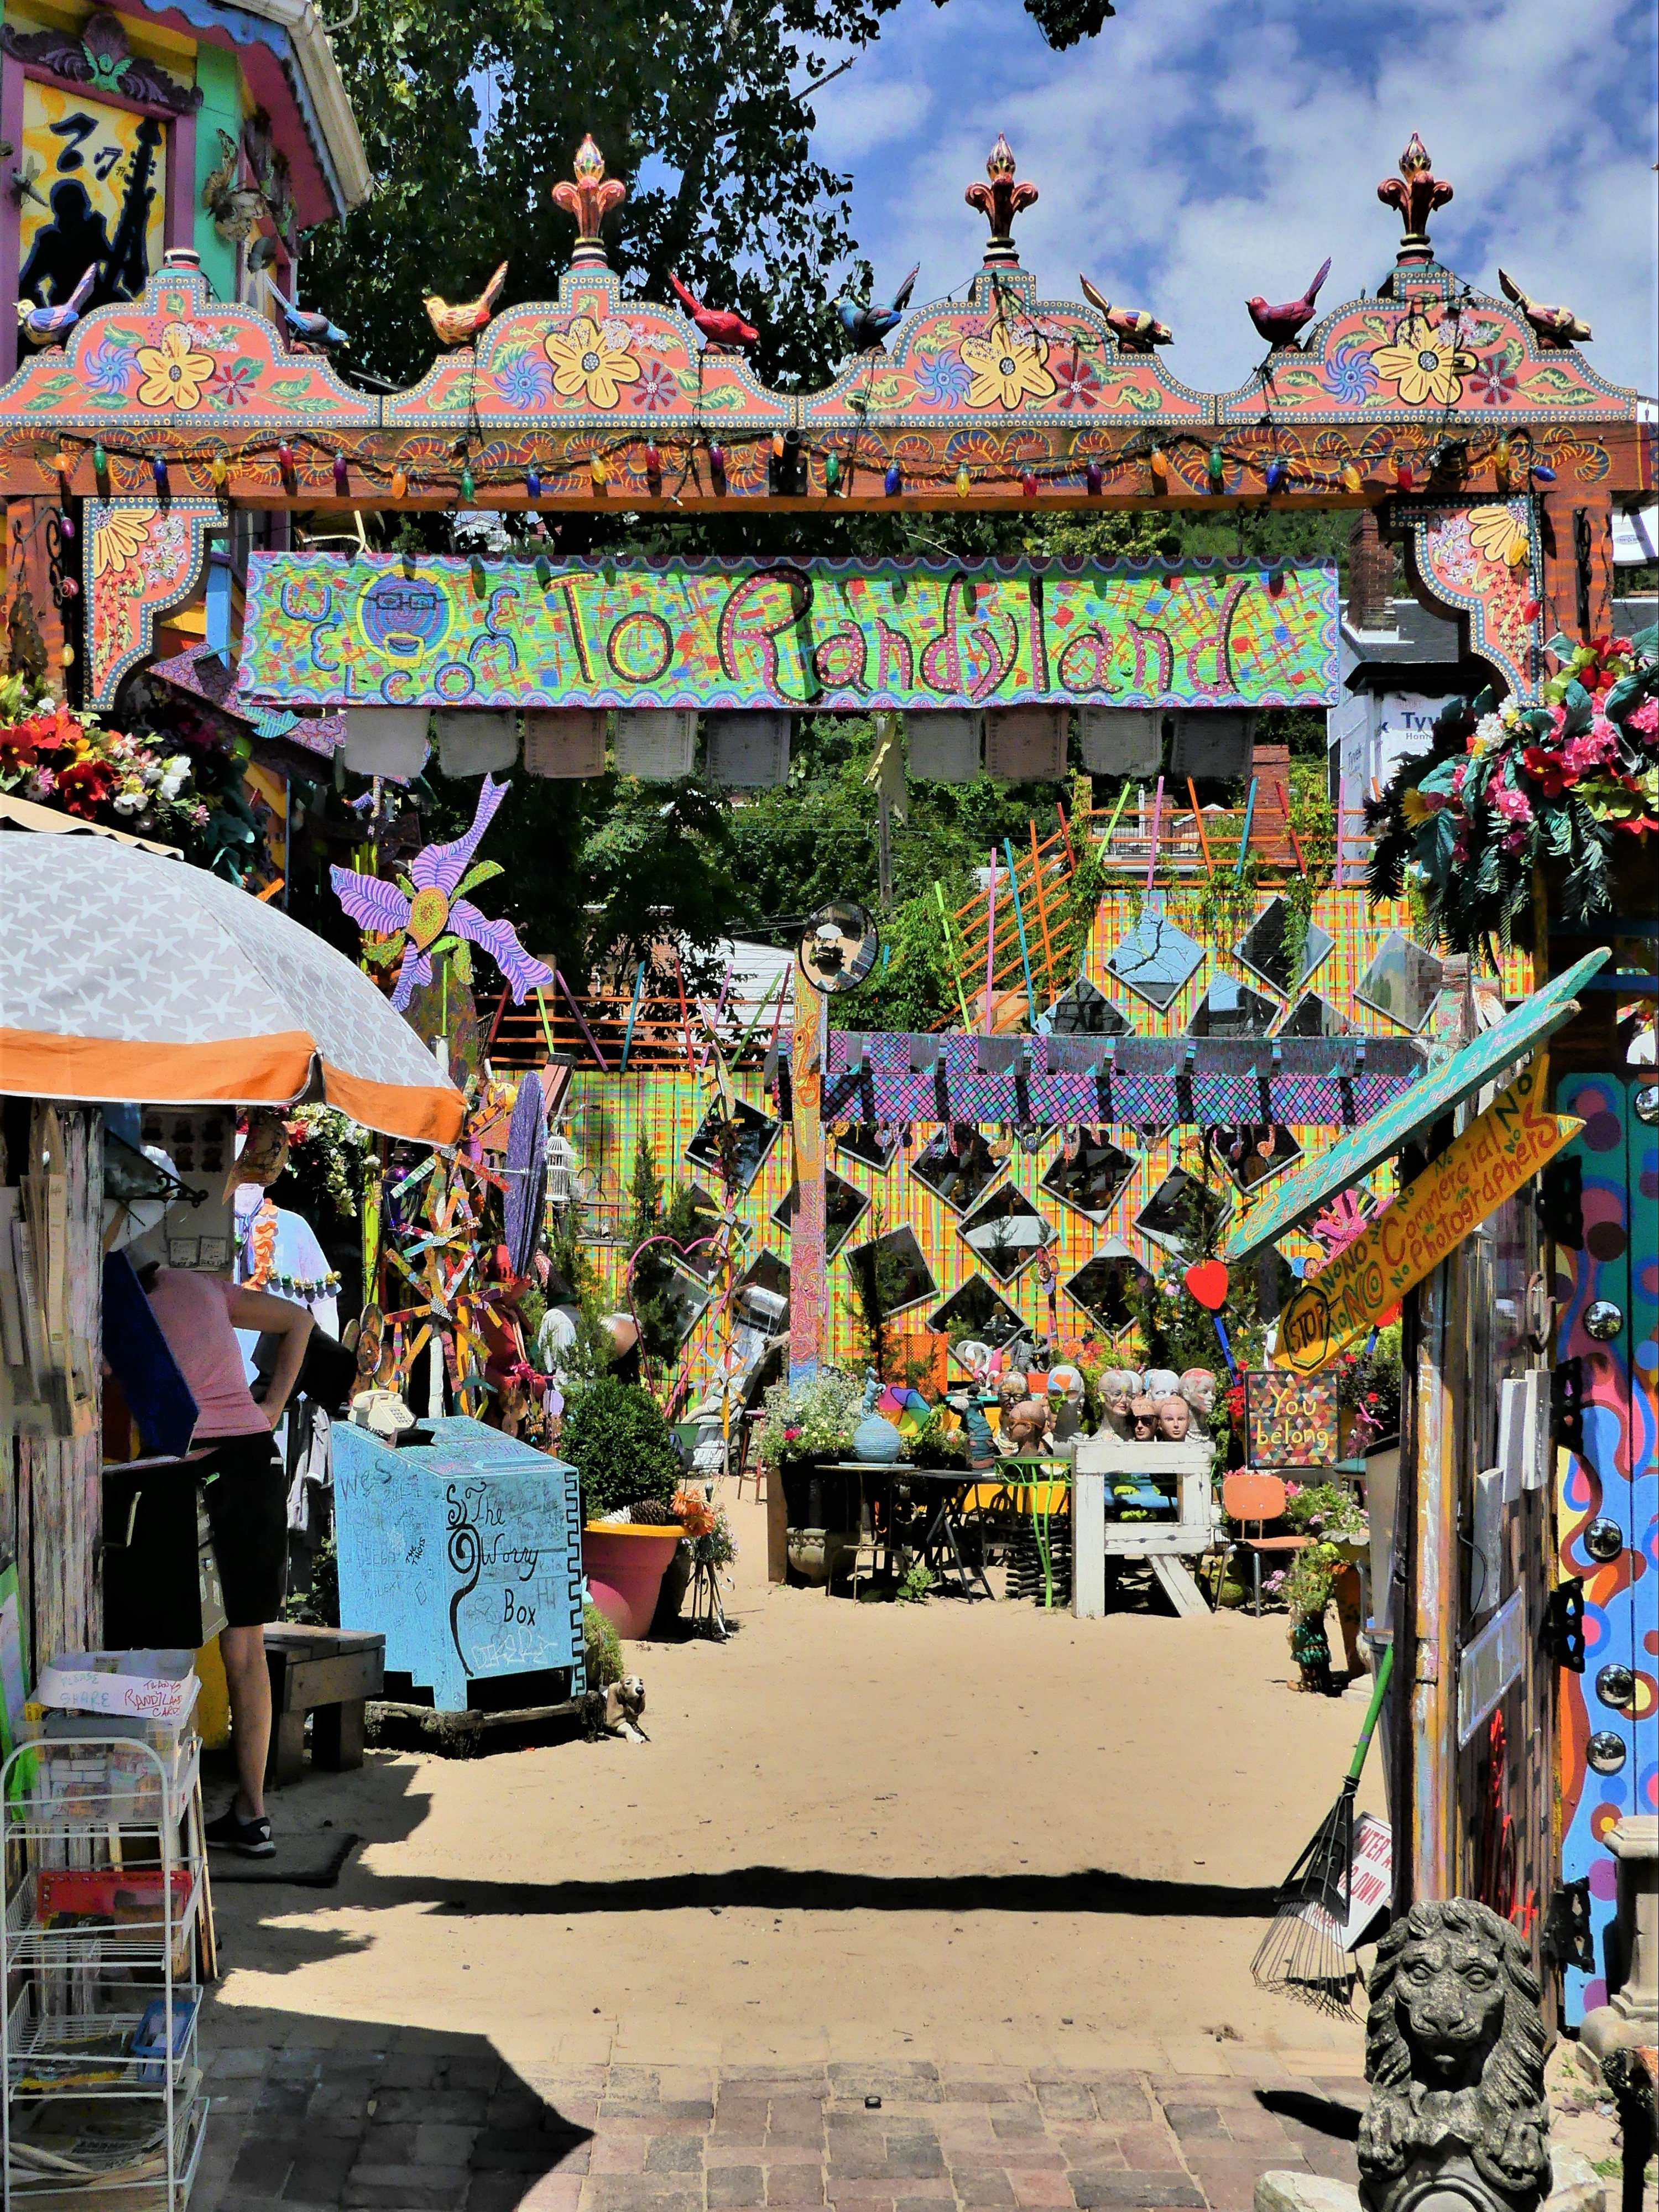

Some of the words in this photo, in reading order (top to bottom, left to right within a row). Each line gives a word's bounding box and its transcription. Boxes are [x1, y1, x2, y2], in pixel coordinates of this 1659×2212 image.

[717, 565, 1250, 705] Randyland
[1383, 1114, 1502, 1267] Commercial
[1289, 1300, 1324, 1355] STOP
[1269, 1385, 1317, 1417] You
[465, 1481, 505, 1526] The
[481, 1532, 539, 1582] Worry
[504, 1588, 536, 1626] Box
[60, 1691, 110, 1709] SHARE
